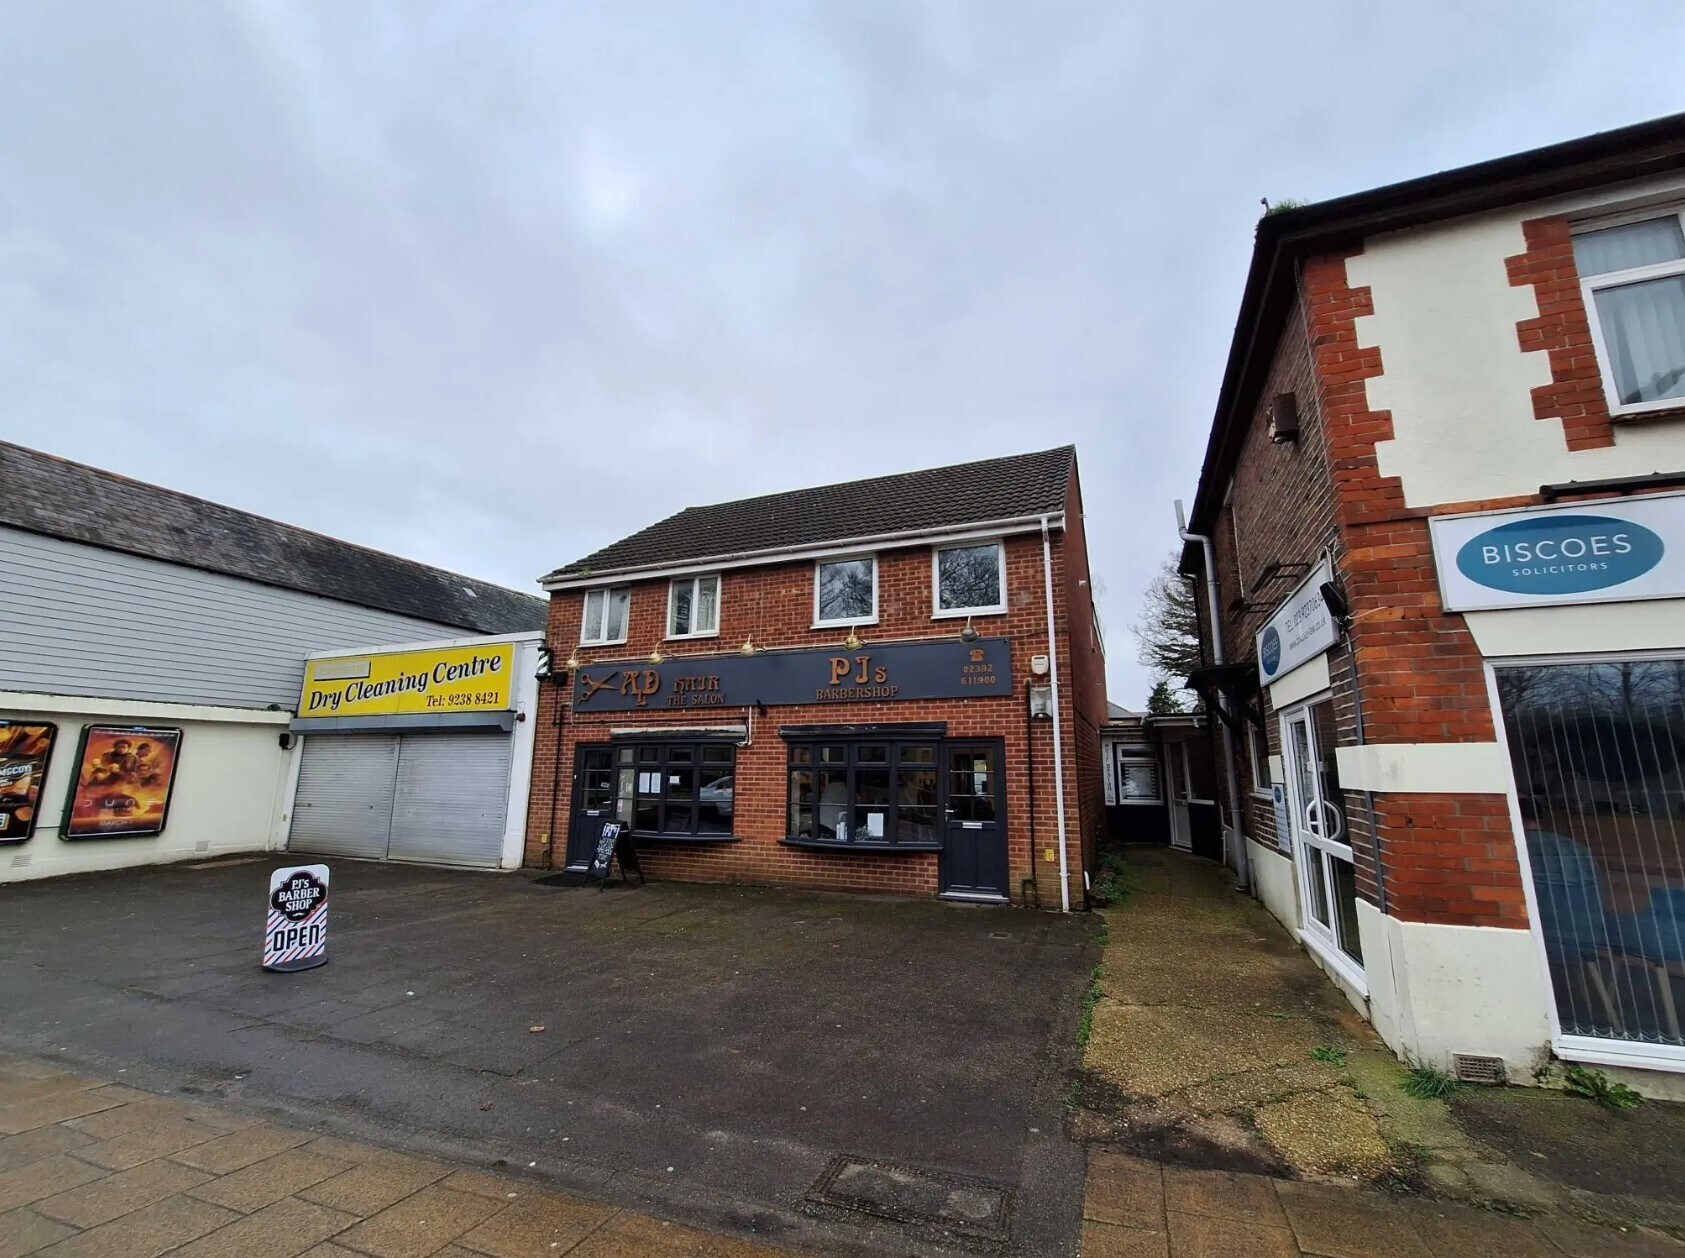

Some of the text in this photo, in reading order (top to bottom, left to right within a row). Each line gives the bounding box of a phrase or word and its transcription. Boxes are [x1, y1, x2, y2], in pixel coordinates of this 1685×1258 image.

[1482, 533, 1632, 564] BISCOES
[1512, 562, 1608, 577] SOLICITORS
[963, 664, 993, 673] 02392
[308, 655, 502, 711] Dry Cleaning Centre
[672, 675, 720, 694] HAIR
[960, 675, 996, 685] 611900
[426, 691, 500, 707] Tel: 9238 8421
[667, 693, 726, 706] THE SALON
[815, 685, 899, 700] BARBERSHOP
[291, 878, 310, 890] PJ'S
[278, 887, 320, 902] BARBER
[285, 899, 313, 912] SHOP
[273, 924, 320, 952] OPEN
